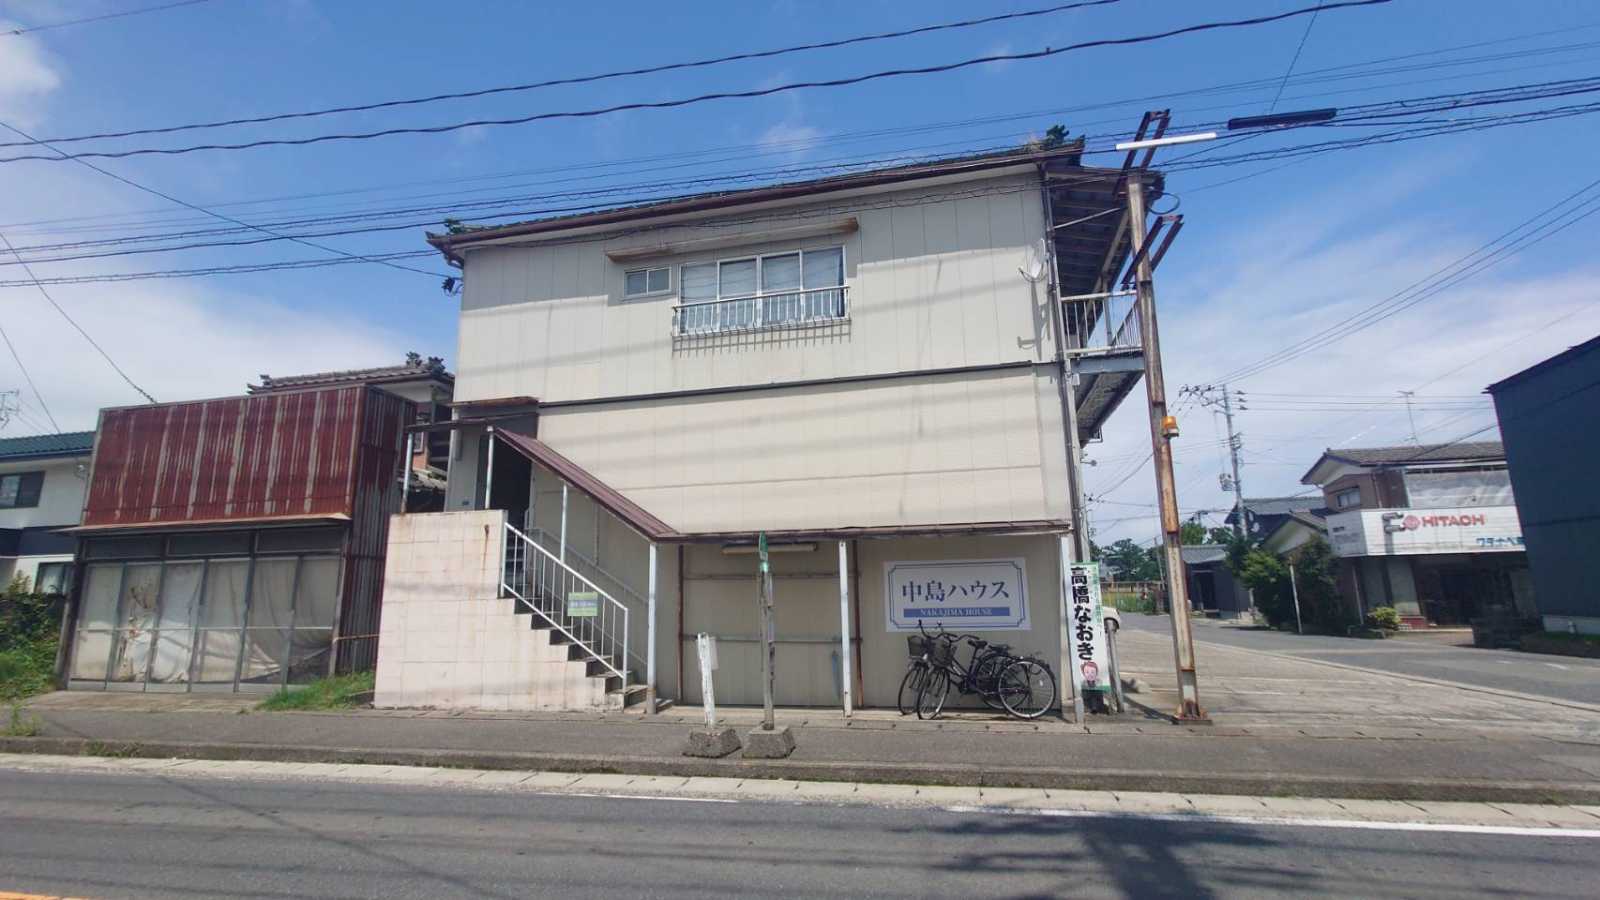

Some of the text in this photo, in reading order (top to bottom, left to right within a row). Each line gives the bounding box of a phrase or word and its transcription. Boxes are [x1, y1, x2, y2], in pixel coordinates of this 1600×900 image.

[902, 580, 1009, 602] 中島ハウス
[920, 607, 993, 617] NAKAJIMA HOUSE
[1071, 566, 1095, 660] 高橋なおき
